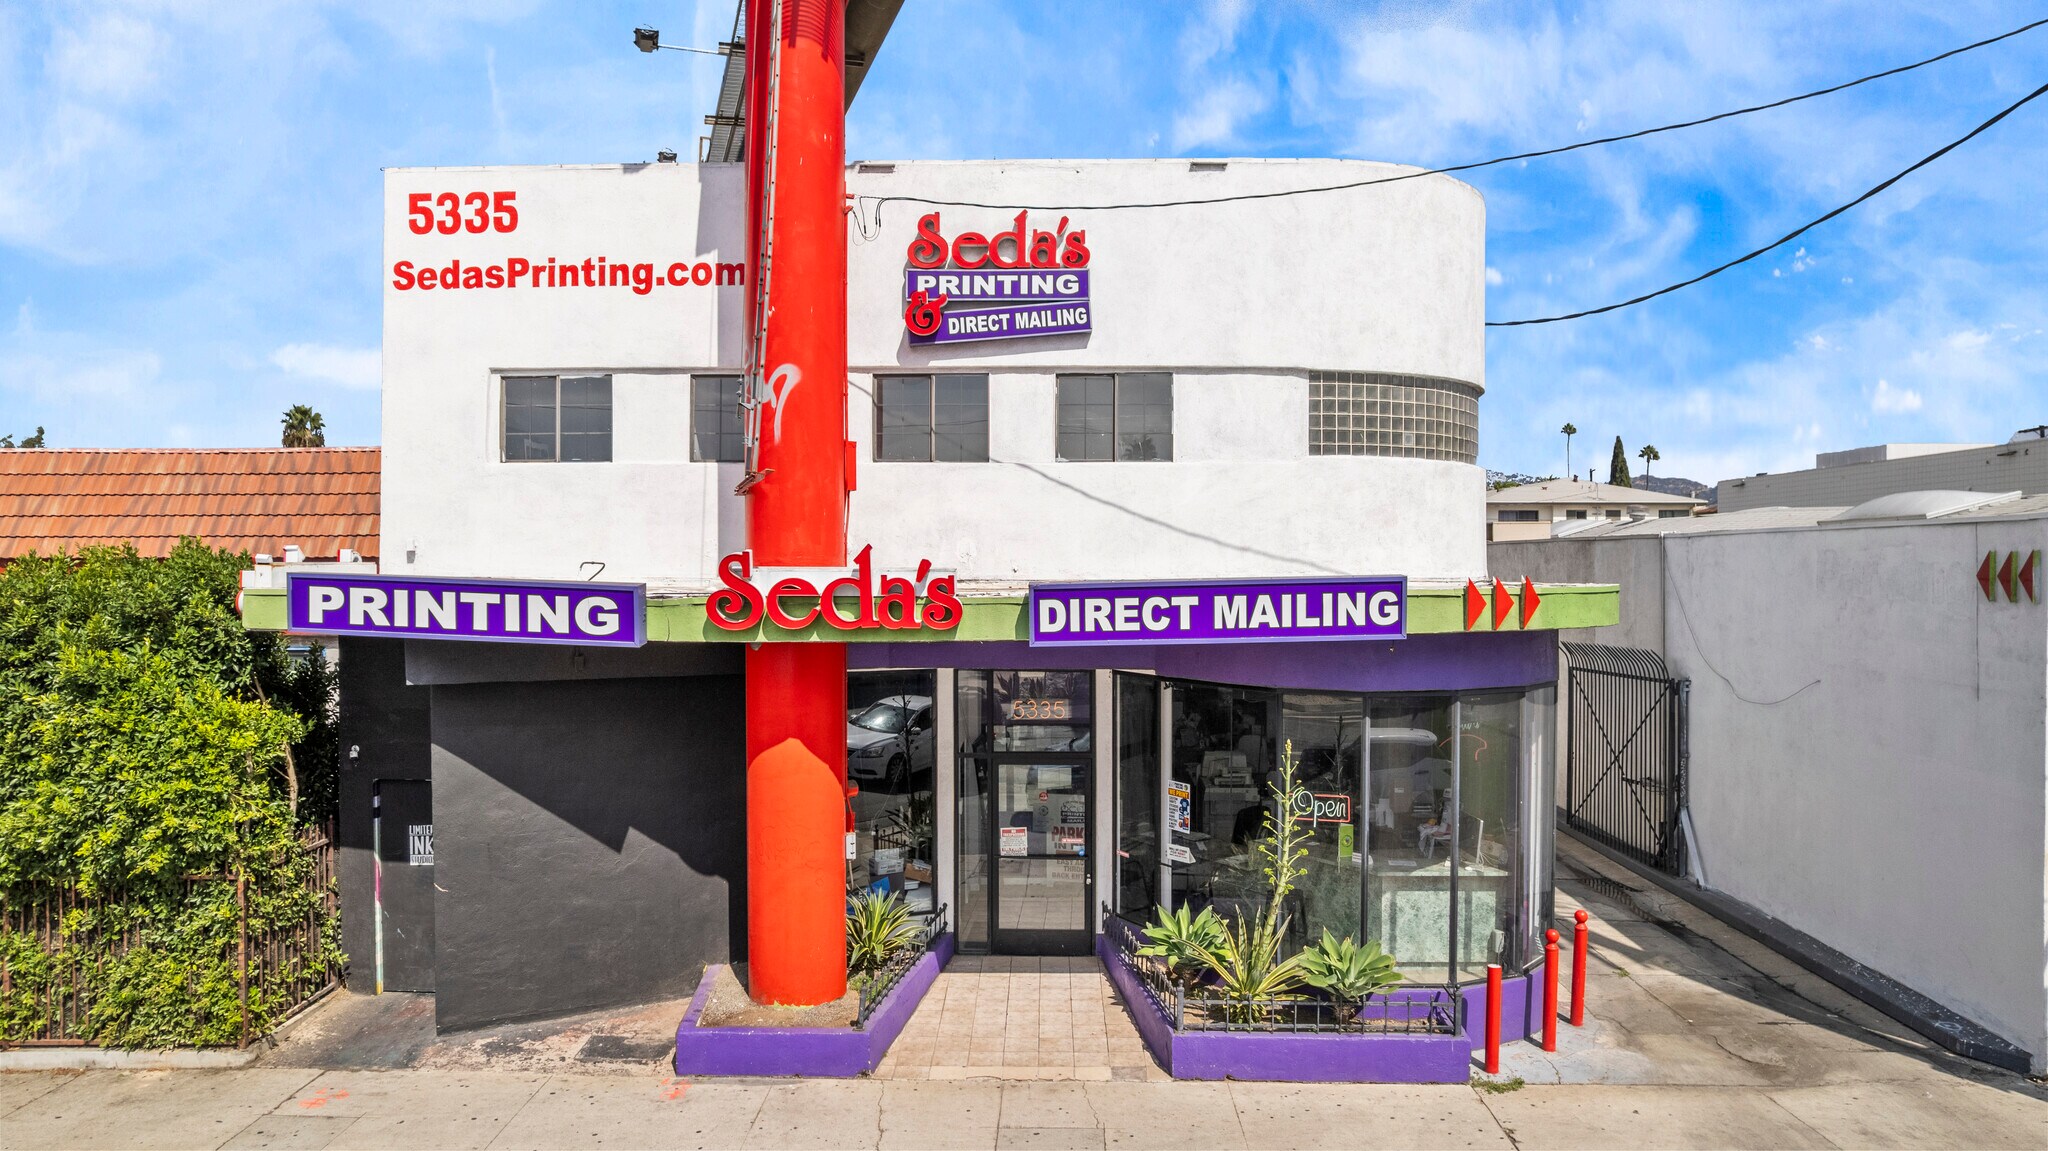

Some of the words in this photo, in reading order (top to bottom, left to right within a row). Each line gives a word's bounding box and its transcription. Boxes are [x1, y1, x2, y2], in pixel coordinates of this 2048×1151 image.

[408, 191, 519, 235] 5335
[907, 209, 1091, 269] Seda's
[392, 256, 745, 295] SedasPrinting.com
[916, 274, 1080, 296] PRINTING
[905, 290, 948, 336] &
[947, 313, 1010, 335] DIRECT
[1015, 306, 1087, 330] MAILING
[706, 543, 963, 631] Seda's
[308, 585, 620, 636] PRINTING
[1038, 595, 1199, 633] DIRECT
[1212, 590, 1400, 631] MAILING
[1013, 700, 1066, 719] 5335
[1292, 787, 1346, 828] Open
[410, 836, 434, 855] INK
